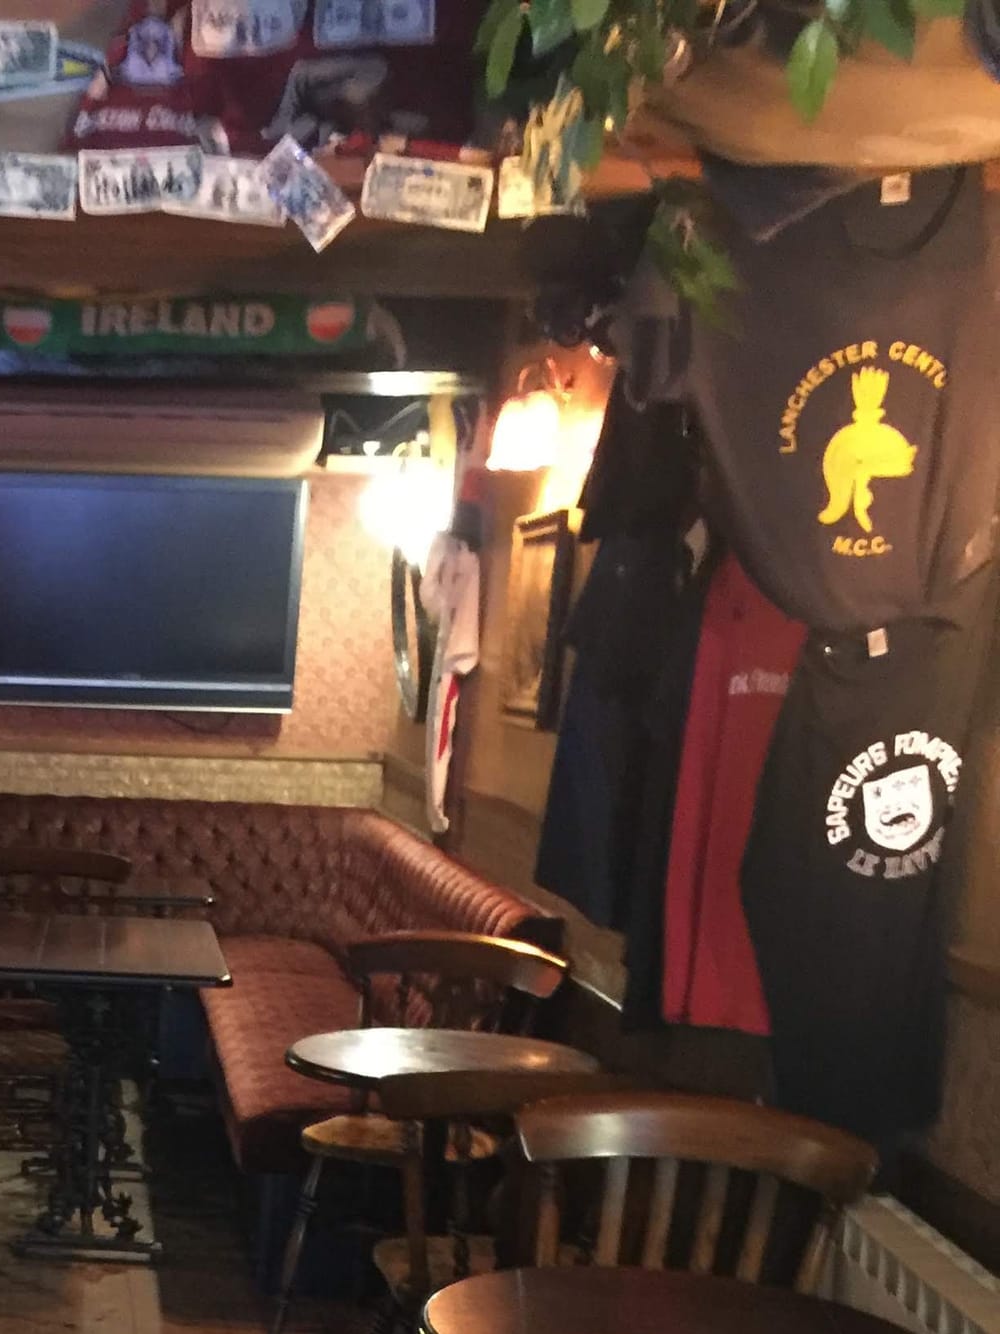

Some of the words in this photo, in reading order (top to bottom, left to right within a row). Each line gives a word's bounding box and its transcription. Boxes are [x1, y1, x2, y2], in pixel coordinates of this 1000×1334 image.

[81, 302, 276, 338] IRELAND
[779, 340, 879, 454] LANCHESTER
[826, 741, 888, 845] SAPEURS
